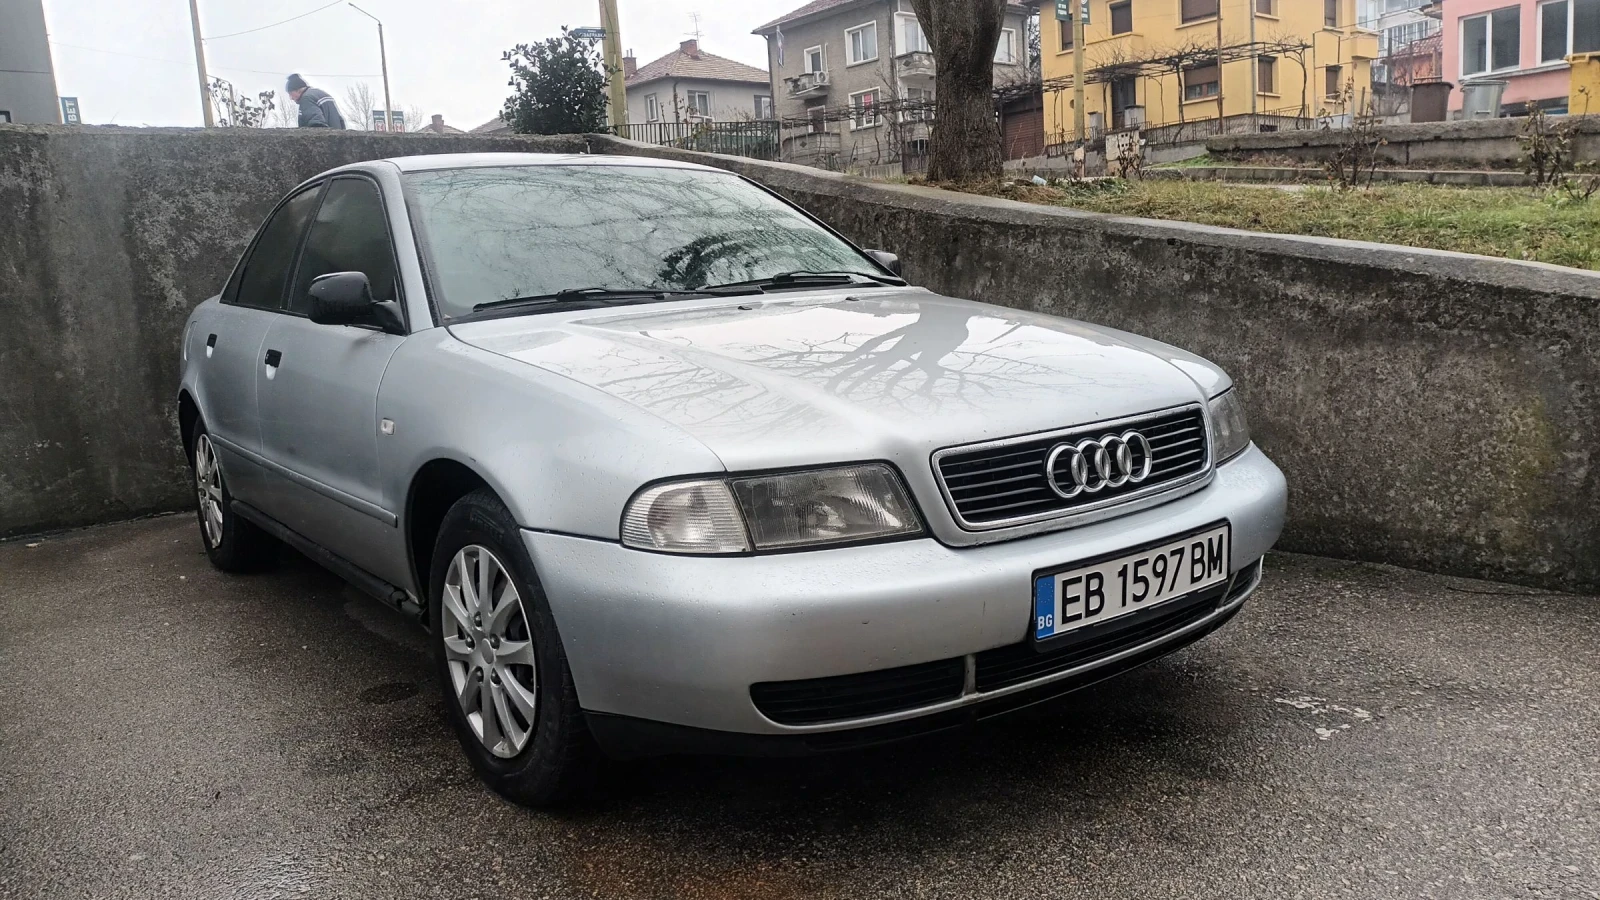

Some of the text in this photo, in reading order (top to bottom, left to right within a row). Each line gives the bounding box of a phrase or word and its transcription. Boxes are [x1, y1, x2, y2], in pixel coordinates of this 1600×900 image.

[1061, 533, 1224, 624] EB 1597 BM
[1037, 613, 1053, 630] BG
